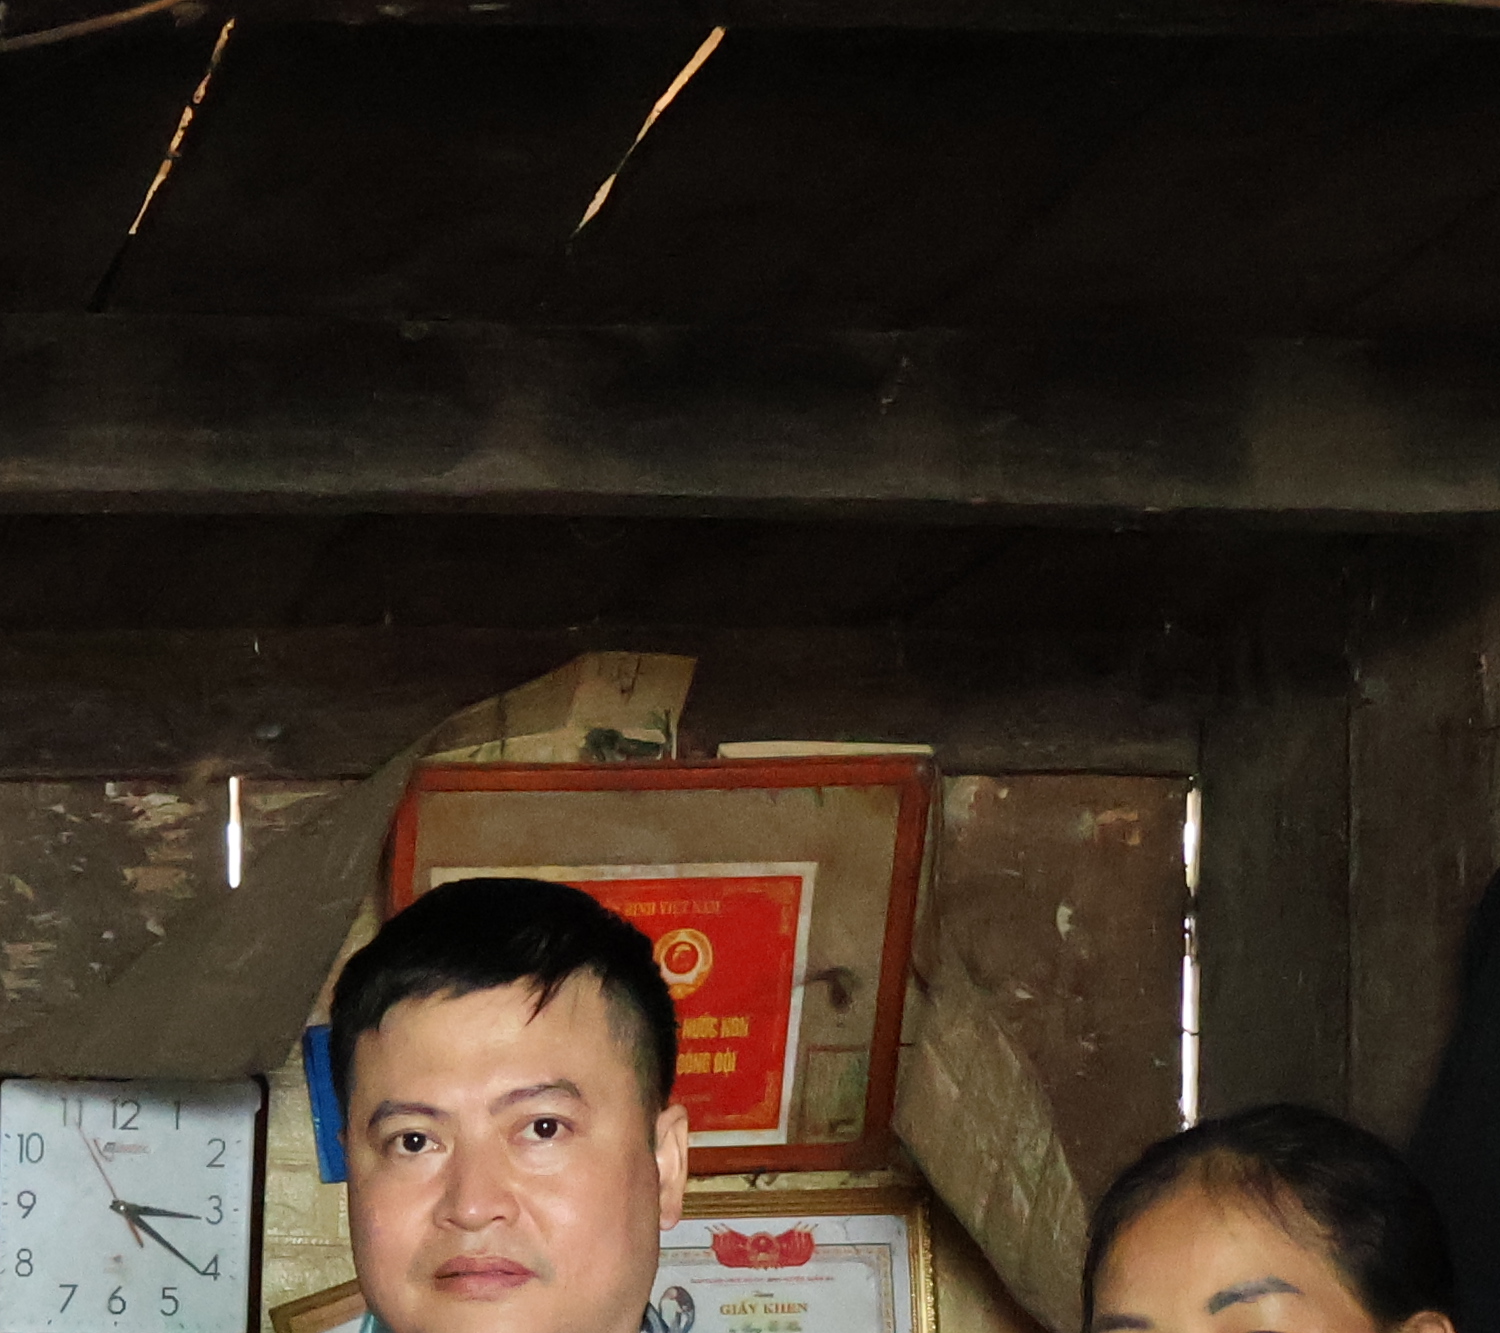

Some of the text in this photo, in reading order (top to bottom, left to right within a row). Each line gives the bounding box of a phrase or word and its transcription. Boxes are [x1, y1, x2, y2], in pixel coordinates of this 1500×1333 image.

[112, 1100, 141, 1130] 12
[17, 1132, 44, 1163] 10
[206, 1138, 225, 1167] 2
[17, 1190, 36, 1219] 9
[206, 1195, 224, 1225] 3
[15, 1248, 33, 1277] 8
[200, 1254, 220, 1281] 4
[59, 1284, 79, 1314] 7
[107, 1286, 127, 1315] 6
[160, 1287, 179, 1316] 5
[763, 1302, 808, 1315] KHEN
